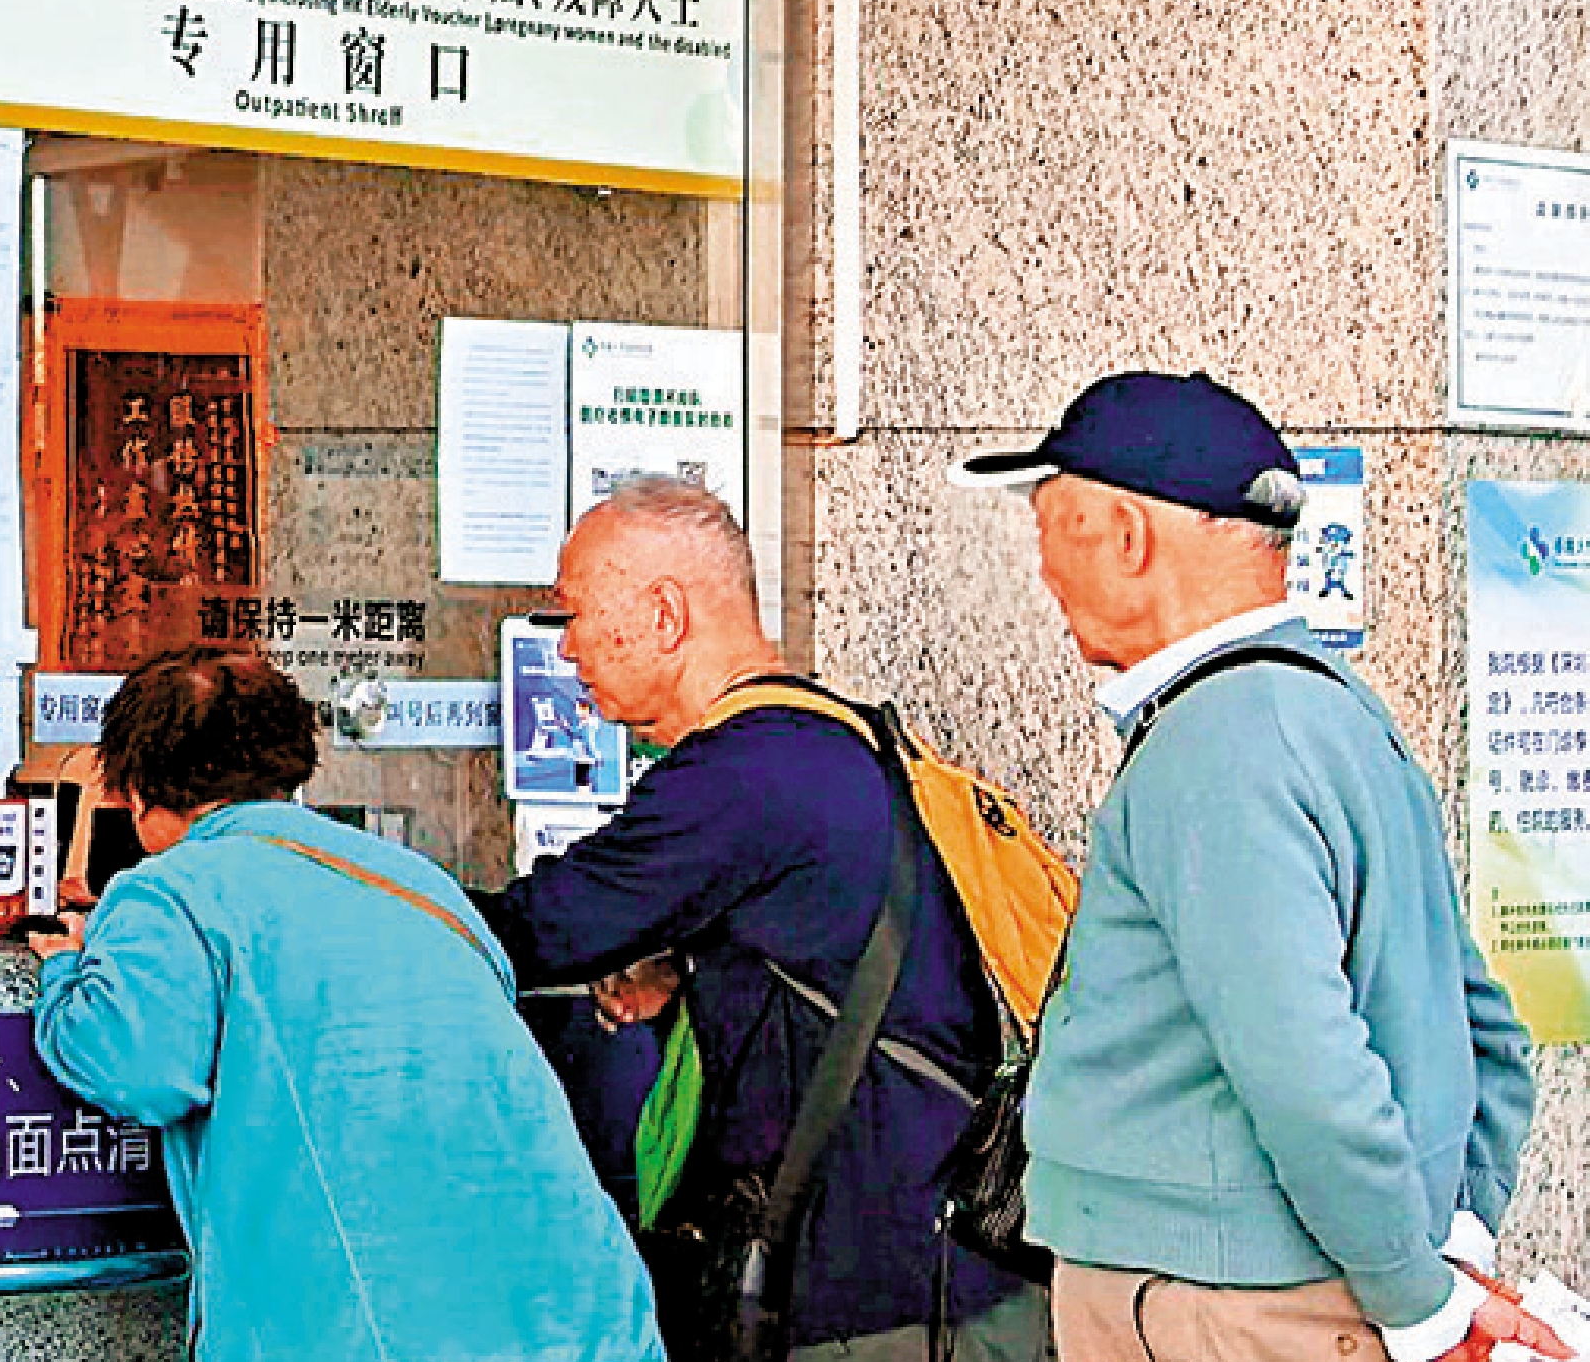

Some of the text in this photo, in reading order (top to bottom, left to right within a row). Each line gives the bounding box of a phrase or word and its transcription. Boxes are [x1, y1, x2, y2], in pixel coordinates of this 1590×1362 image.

[161, 5, 469, 103] 专用窗口
[198, 597, 426, 641] 请保持一米距离
[40, 692, 105, 722] 专用窗
